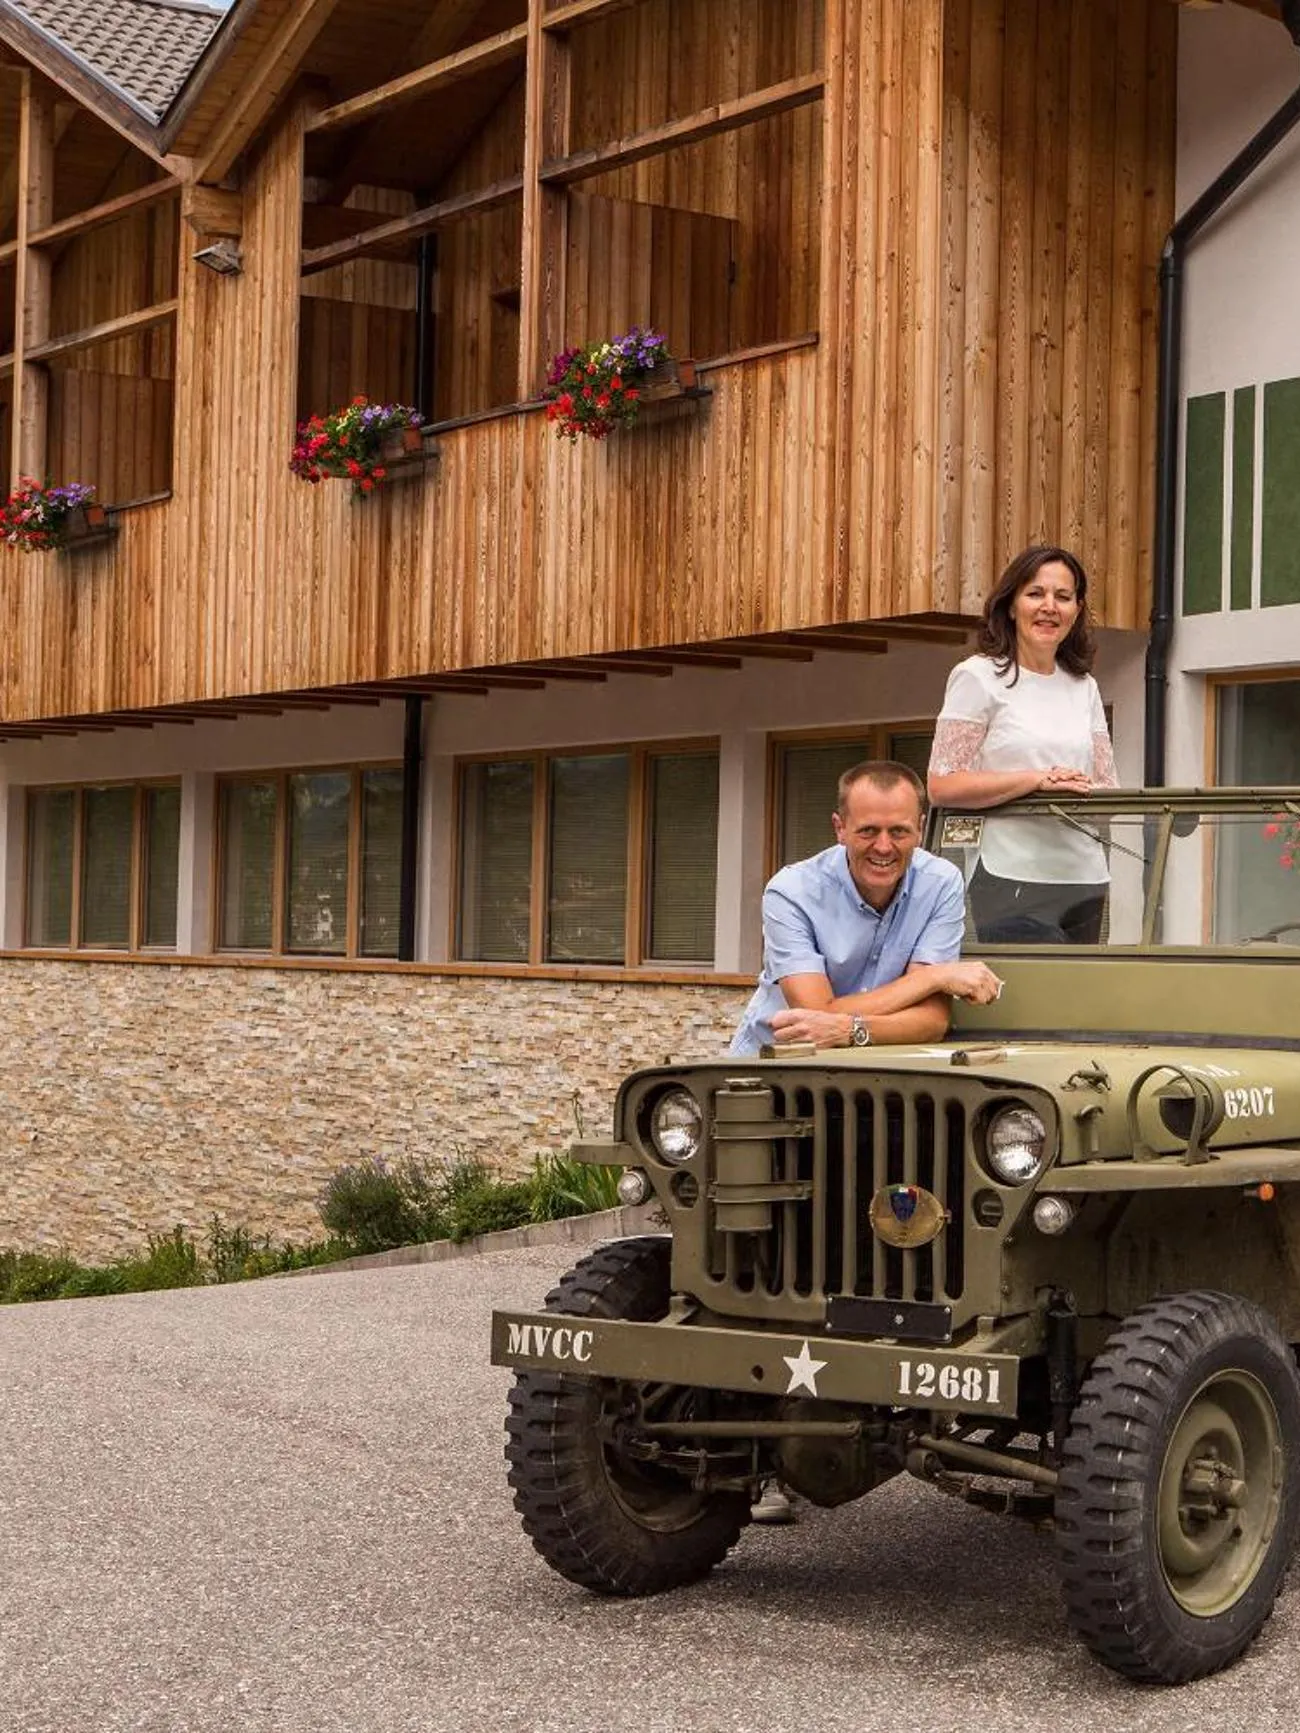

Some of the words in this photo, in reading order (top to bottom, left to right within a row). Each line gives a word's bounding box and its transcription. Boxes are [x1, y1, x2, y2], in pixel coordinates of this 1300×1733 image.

[1223, 1086, 1275, 1119] 6207
[507, 1323, 594, 1362] MVCC
[898, 1361, 1001, 1404] 12681
